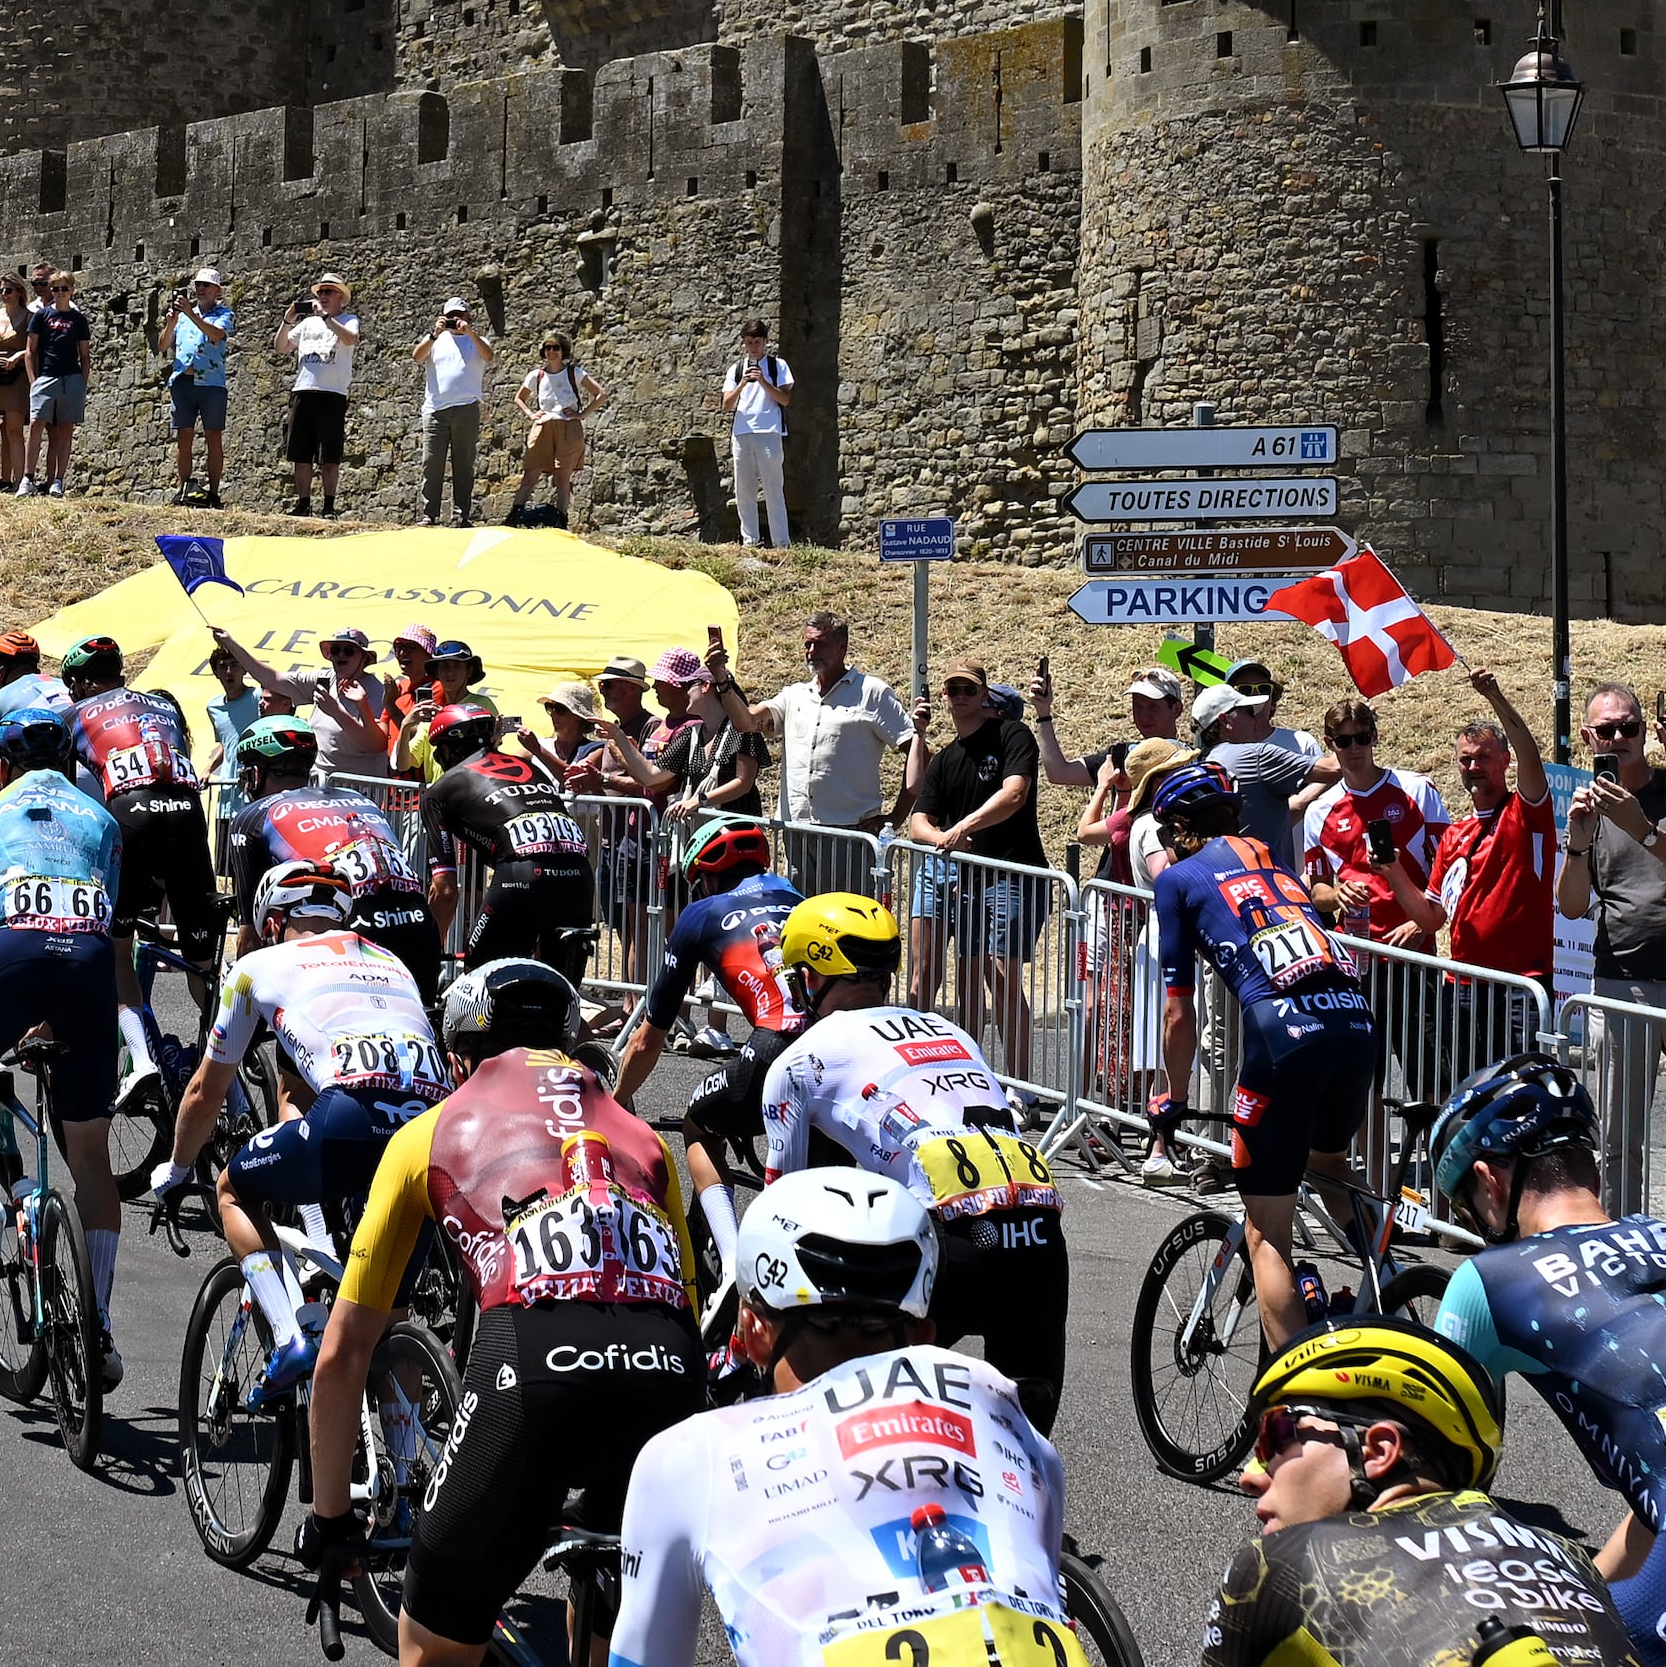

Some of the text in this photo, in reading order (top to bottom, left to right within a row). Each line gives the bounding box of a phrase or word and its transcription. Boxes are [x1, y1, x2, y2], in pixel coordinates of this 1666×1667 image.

[1251, 436, 1297, 456] A 61
[1108, 487, 1331, 512] TOUTES DIRECTIONS
[906, 523, 926, 533] RUE
[908, 535, 951, 545] NADAUD
[1116, 538, 1169, 553] CENTRE
[1177, 537, 1213, 551] VILLE
[1219, 535, 1270, 550] Bastide
[1296, 534, 1331, 549] Louis
[1138, 551, 1239, 568] Canal du Midi
[244, 577, 600, 622] CARCASSONNE
[1107, 586, 1268, 617] PARKING
[254, 628, 317, 655] LE
[104, 690, 178, 715] DECATHLON
[102, 714, 140, 731] CMA
[244, 734, 276, 752] RYSEL
[113, 751, 144, 782] 54
[149, 798, 192, 814] Shine
[525, 798, 553, 806] sportful
[297, 813, 348, 834] CMA
[510, 816, 553, 848] 193
[543, 867, 581, 877] TUDOR
[501, 881, 531, 890] sportful
[14, 882, 108, 922] 66 66
[373, 907, 425, 929] Shine
[468, 912, 490, 949] TUDOR
[819, 923, 841, 935] MET
[806, 940, 834, 963] G42
[1257, 926, 1316, 973] 217
[296, 961, 411, 980] TotalEnergies
[348, 972, 390, 984] ADM
[1275, 957, 1326, 991] VELUX
[737, 970, 765, 998] CMA
[1304, 990, 1371, 1012] raisin
[869, 1015, 954, 1042] UAE
[1300, 1022, 1325, 1034] Nalini
[283, 1025, 315, 1075] VENDÉE
[336, 1039, 401, 1077] 208
[904, 1041, 963, 1064] Emirates
[704, 1070, 730, 1096] CGM
[920, 1071, 990, 1097] XRG
[1501, 1114, 1539, 1145] RUDY
[240, 1151, 282, 1172] TotalEnergies
[946, 1138, 1050, 1189] 8 8
[771, 1213, 803, 1233] MET
[1396, 1202, 1419, 1227] 217
[513, 1195, 601, 1281] 163
[1002, 1216, 1048, 1250] IHC
[441, 1215, 505, 1288] Cofidis
[755, 1251, 789, 1290] G42
[545, 1342, 685, 1375] Cofidis
[823, 1356, 973, 1415] UAE
[1354, 1373, 1391, 1391] VISMA
[1401, 1382, 1427, 1395] lease
[765, 1404, 815, 1423] Analog
[851, 1411, 967, 1446] Emirates
[422, 1390, 479, 1512] Cofidis
[766, 1445, 809, 1471] G42
[1002, 1448, 1026, 1471] IHC
[849, 1454, 985, 1503] XRG
[767, 1496, 840, 1525] RICHARD MILLE
[1394, 1515, 1581, 1574] VISMA
[1443, 1559, 1587, 1592] lease
[1007, 1595, 1028, 1612] DEL
[856, 1612, 889, 1631] DEL
